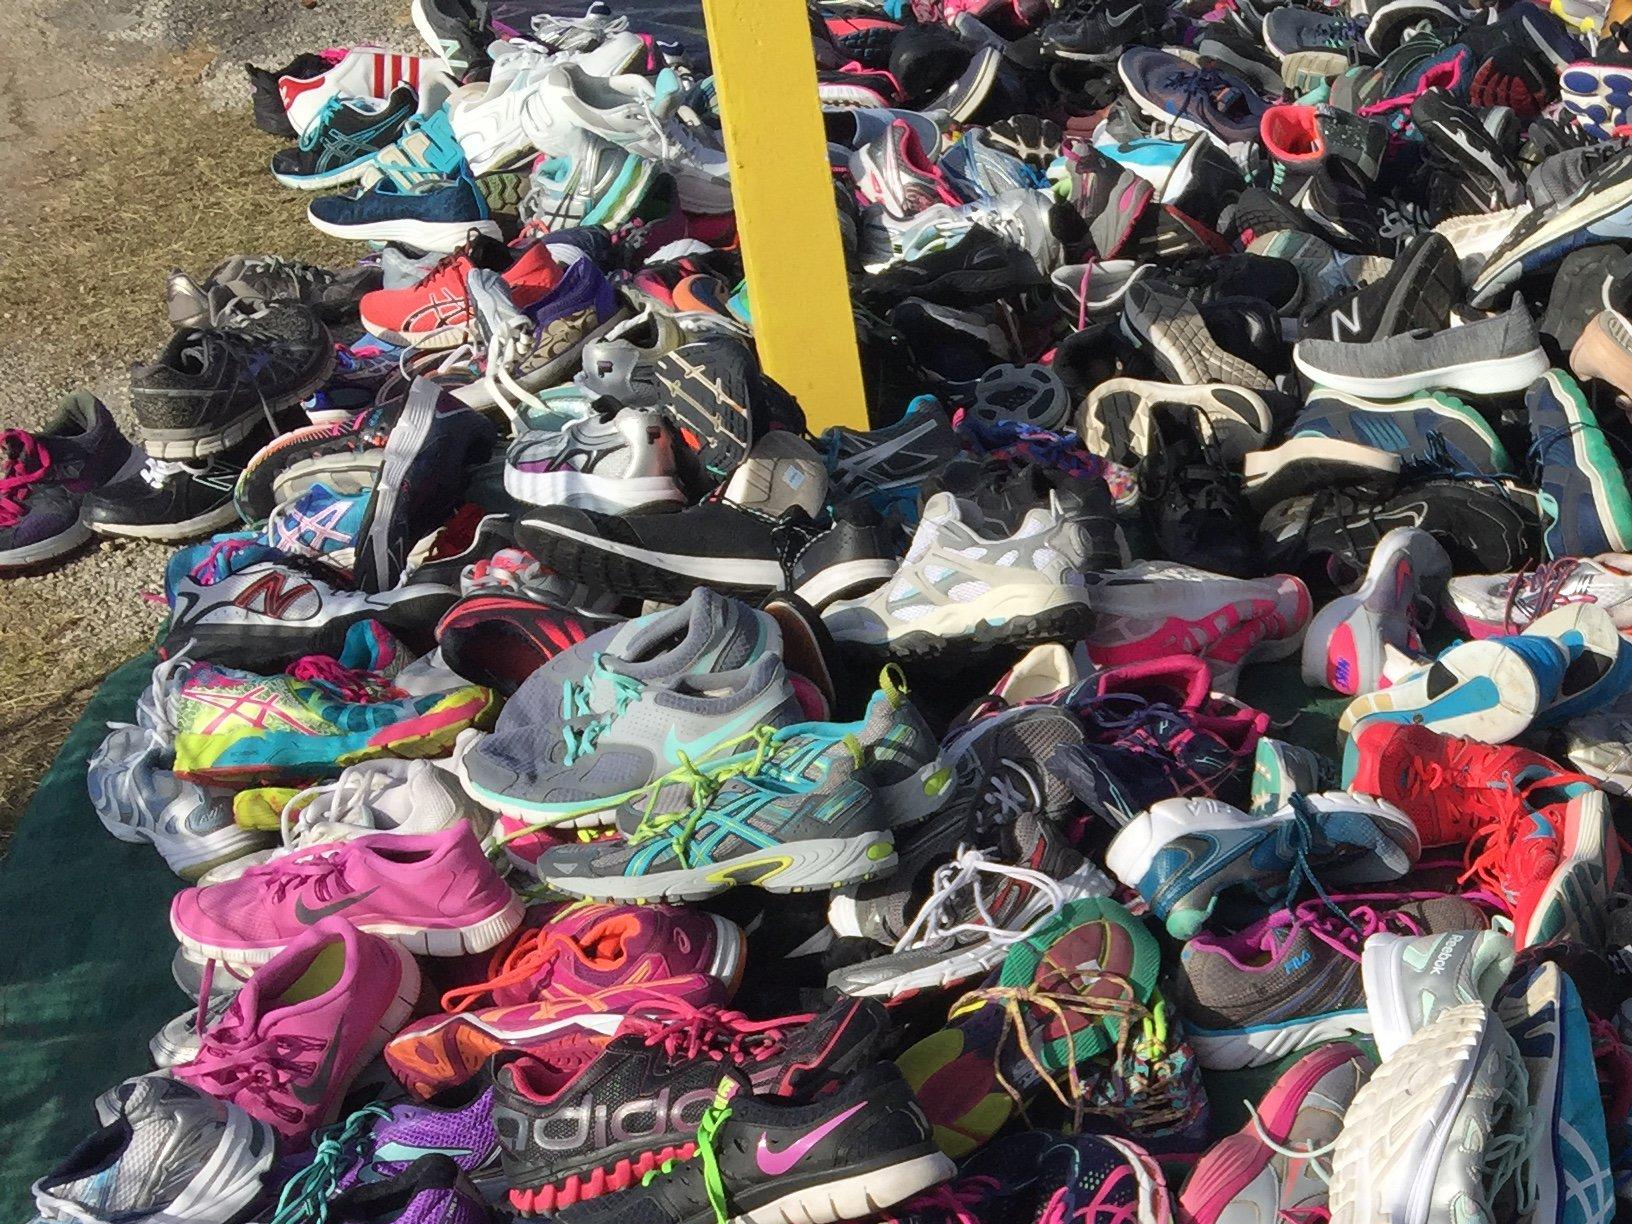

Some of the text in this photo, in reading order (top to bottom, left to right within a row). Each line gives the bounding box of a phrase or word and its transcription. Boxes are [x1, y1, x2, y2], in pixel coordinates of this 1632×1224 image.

[1331, 296, 1360, 342] N
[232, 570, 314, 619] N
[1284, 949, 1311, 975] FILA
[1430, 934, 1465, 975] Reebok
[496, 1086, 718, 1151] adida
